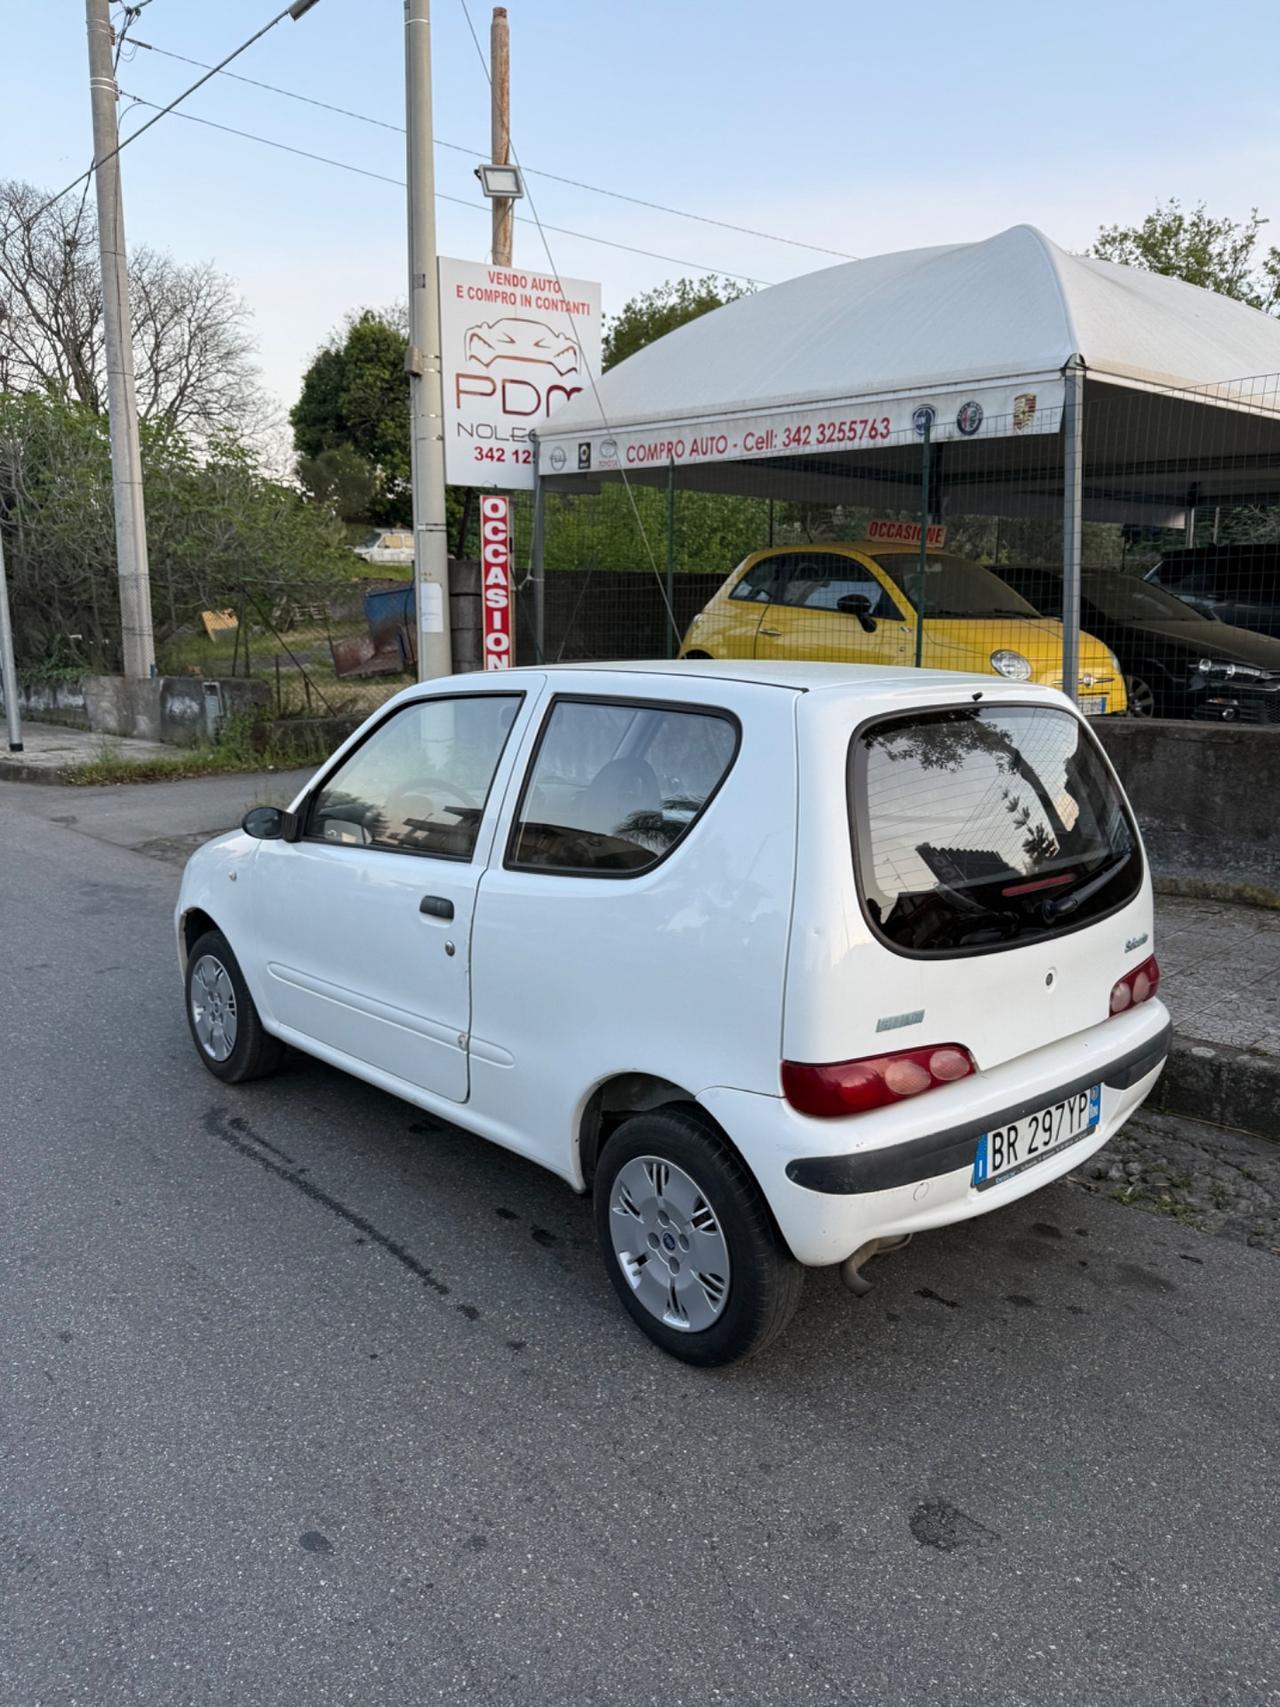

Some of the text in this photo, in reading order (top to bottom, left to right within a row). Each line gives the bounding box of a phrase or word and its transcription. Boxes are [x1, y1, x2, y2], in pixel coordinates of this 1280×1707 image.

[488, 270, 561, 294] VENDO AUTO
[456, 284, 590, 316] E COMPRO IN CONTANTI
[474, 446, 506, 463] 342
[511, 449, 536, 465] 12
[626, 439, 685, 463] COMPRO
[689, 434, 728, 458] AUTO
[743, 428, 778, 452] Cell:
[782, 425, 812, 448] 342
[816, 416, 891, 444] 3255763
[992, 1125, 1019, 1171] BR
[1027, 1093, 1088, 1154] 297YP
